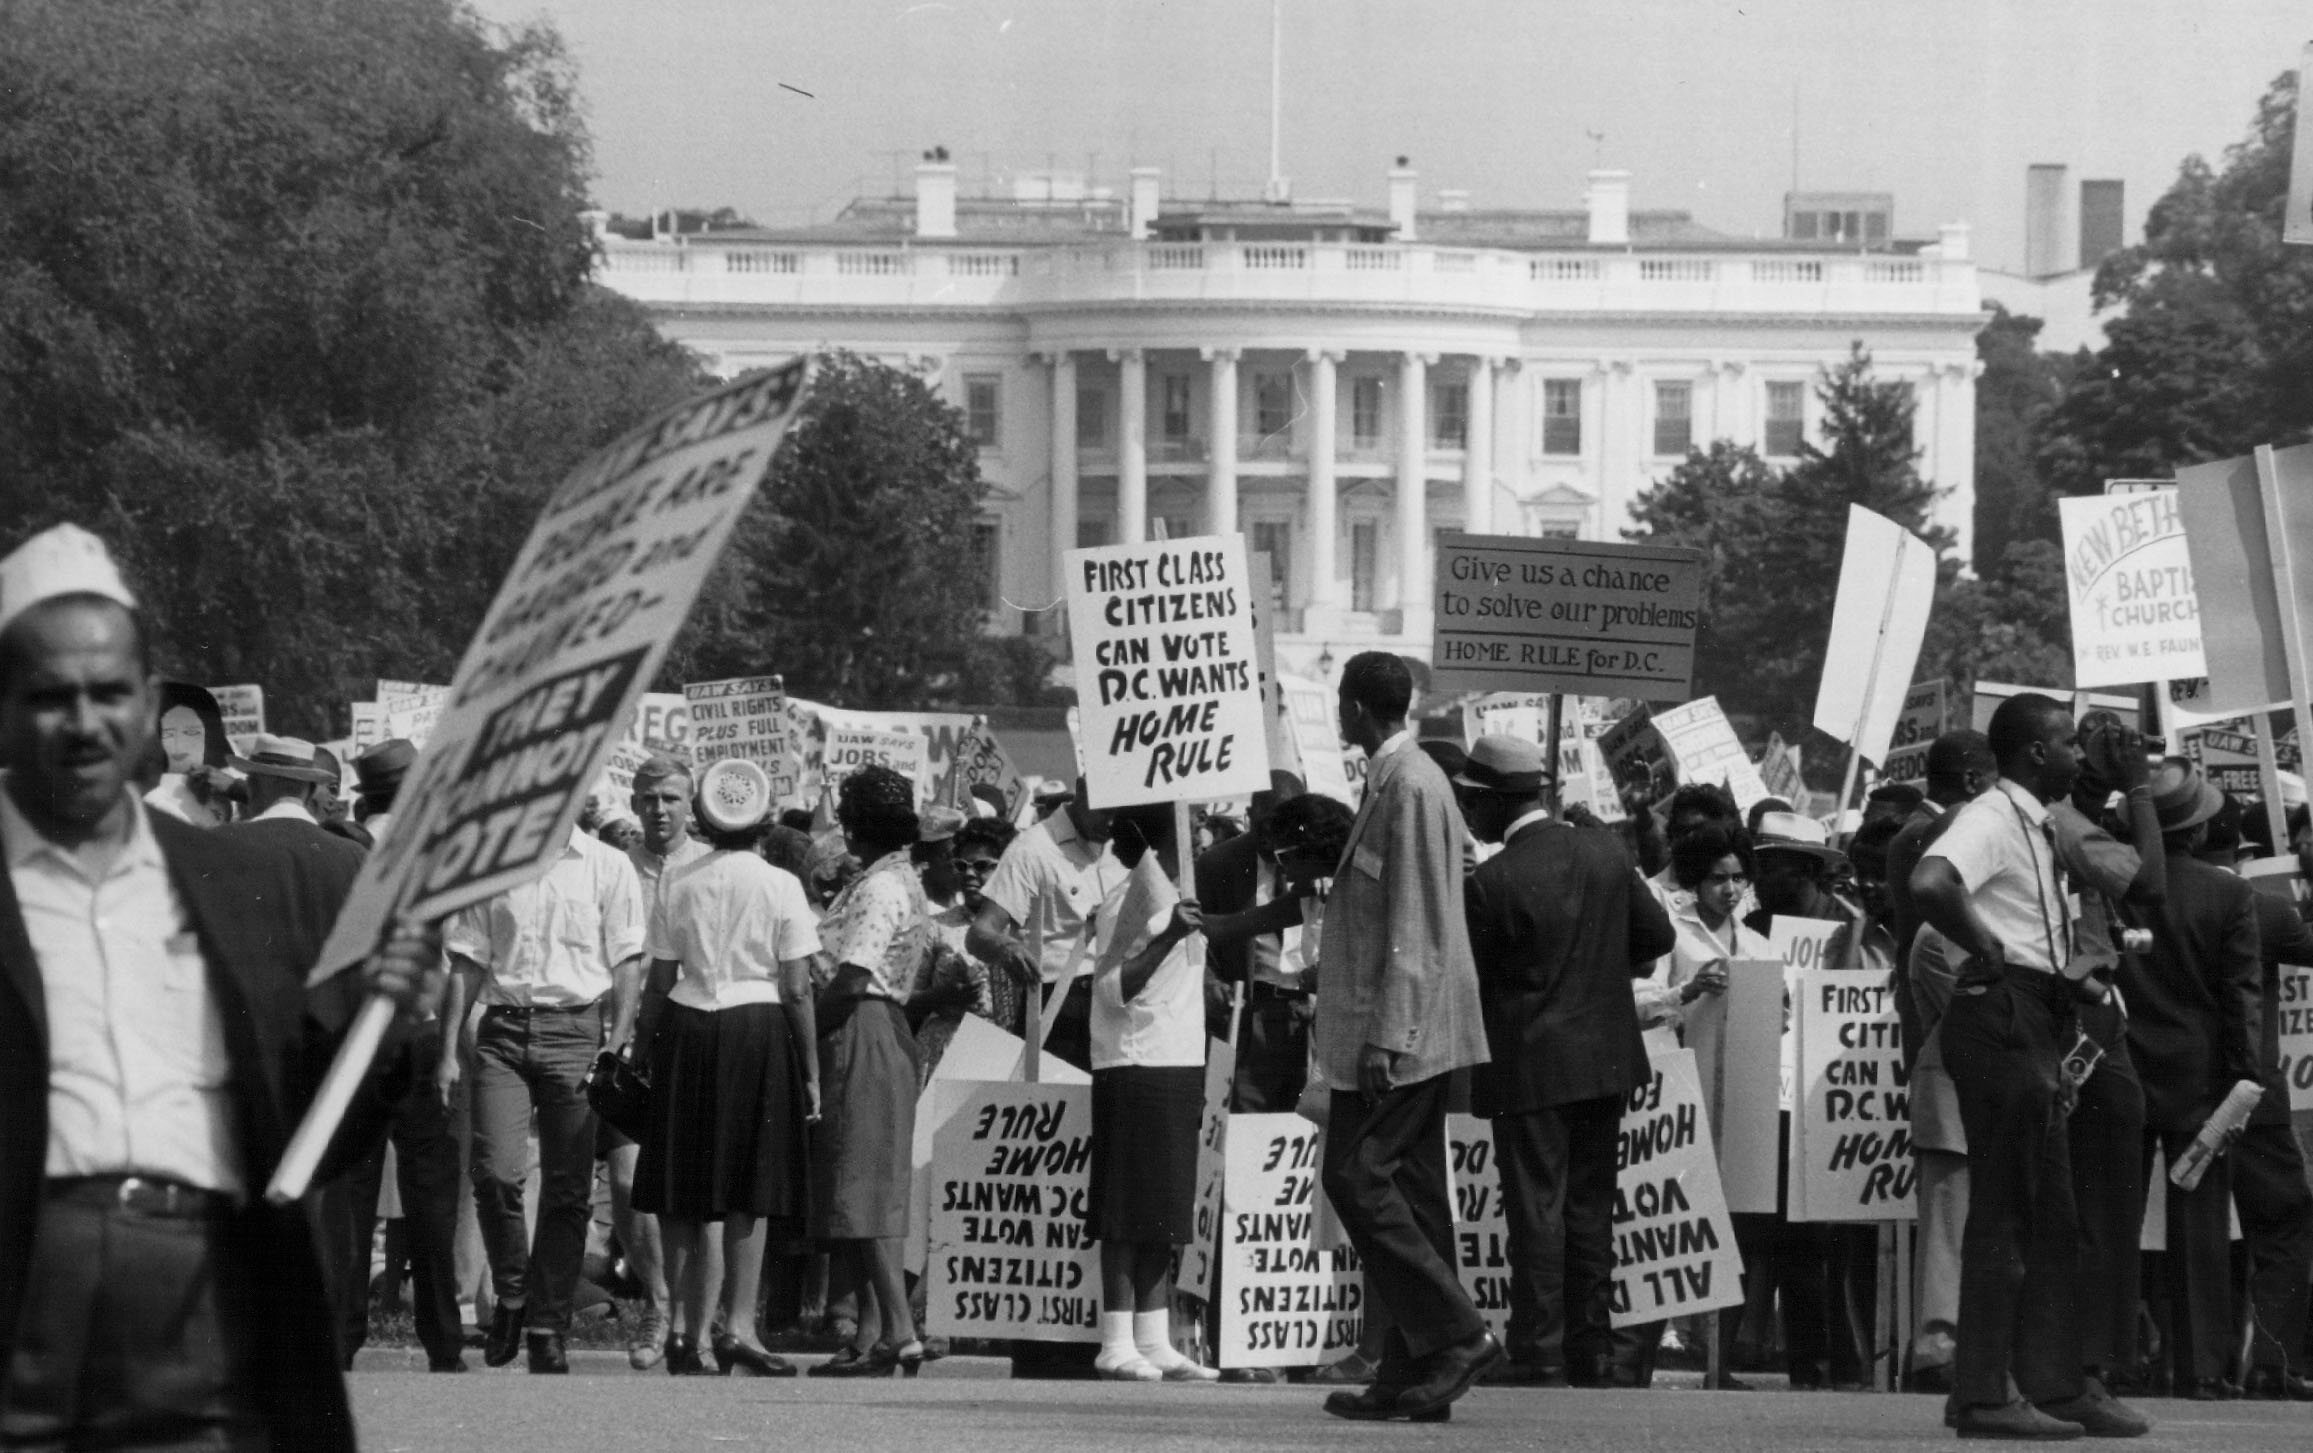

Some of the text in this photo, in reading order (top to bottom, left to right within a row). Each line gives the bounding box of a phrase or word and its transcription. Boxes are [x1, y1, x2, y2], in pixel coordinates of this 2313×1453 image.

[1083, 550, 1225, 593] FIRST CLASS
[1452, 555, 1671, 593] Give us a chance
[2070, 519, 2113, 600] NEW
[2116, 566, 2195, 601] BAPTI
[1105, 586, 1237, 628] CITIZENS
[1442, 590, 1698, 633] to solve our problems
[1095, 630, 1231, 667] CAN VOTE
[1444, 640, 1665, 675] HOME RULE for D.C.
[1157, 658, 1250, 699] WANTS
[485, 661, 624, 760] THEY
[691, 696, 782, 720] CIVIL RIGHTS
[697, 717, 782, 741] PLUS FULL
[1109, 699, 1219, 756] HOME
[831, 748, 890, 767] JOBS
[1143, 733, 1235, 788] RULE
[1822, 984, 1886, 1014] FIRST
[1838, 1022, 1900, 1049] CITI
[1825, 1059, 1879, 1086] CAN
[972, 1099, 1067, 1143] RULE
[984, 1135, 1092, 1177] HOME
[941, 1180, 1042, 1216] WANTS
[962, 1215, 1035, 1248] VOTE
[946, 1255, 1083, 1291] CITIZENS
[1255, 1246, 1321, 1274] VOTE
[1240, 1282, 1362, 1315] CITIZENS
[1643, 1261, 1712, 1307] ALL
[954, 1290, 1098, 1329] FIRST CLASS
[1247, 1319, 1318, 1351] CLASS
